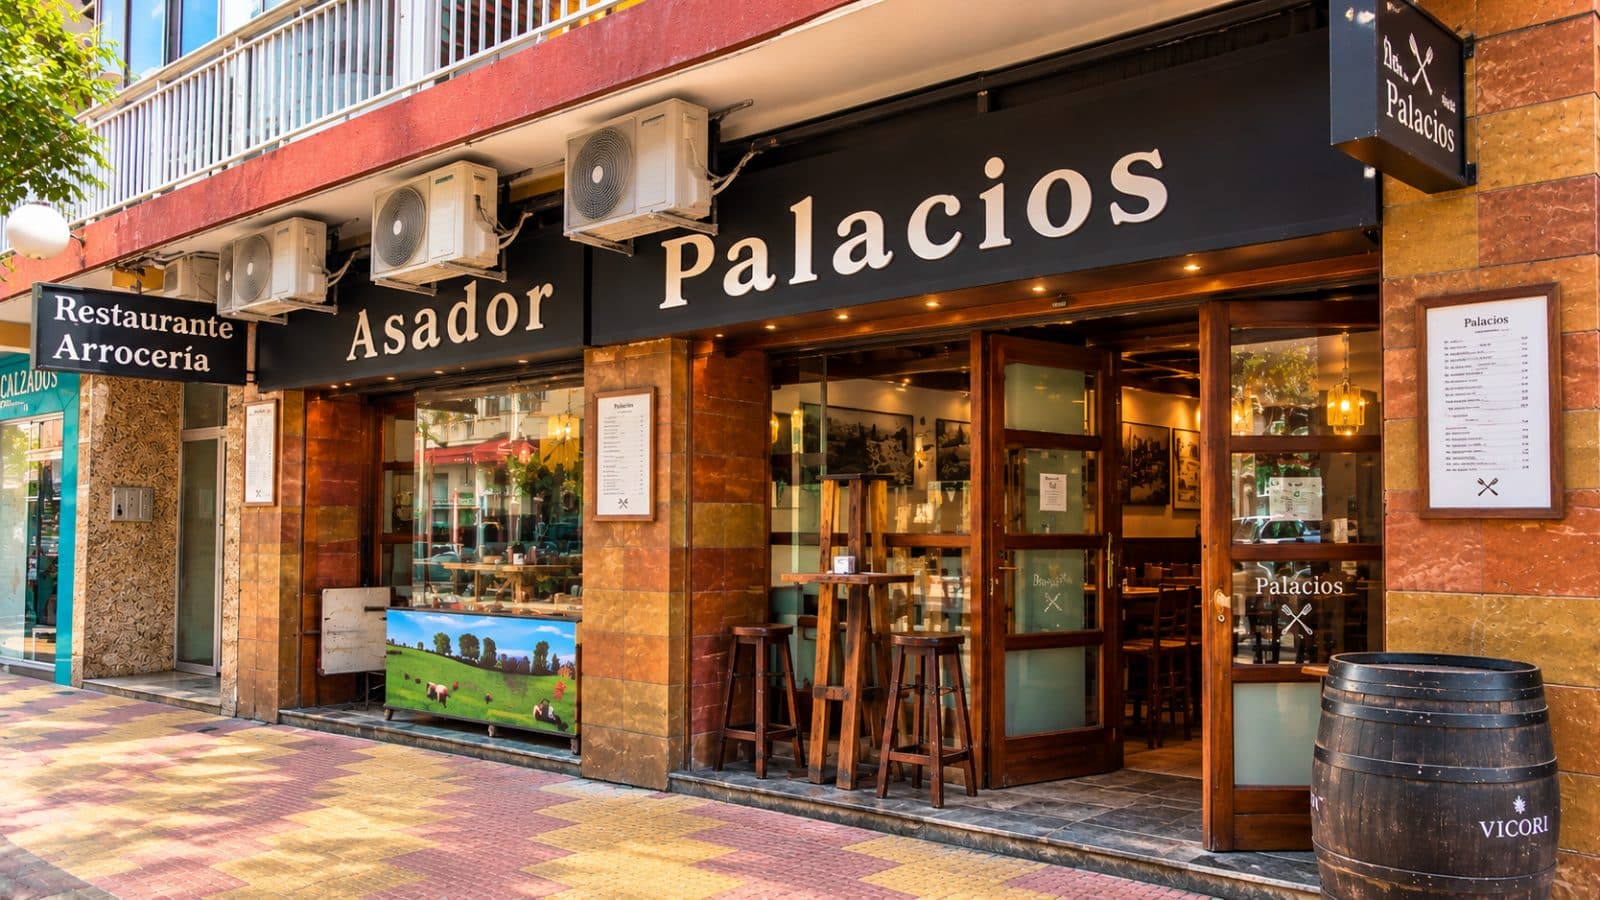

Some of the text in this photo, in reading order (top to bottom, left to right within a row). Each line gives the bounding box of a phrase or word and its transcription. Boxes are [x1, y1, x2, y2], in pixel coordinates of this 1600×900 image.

[1385, 79, 1456, 153] Palacios
[659, 147, 1169, 310] Palacios
[53, 294, 234, 340] Restaurante
[346, 279, 554, 361] Asador
[1464, 316, 1509, 328] Palacios
[52, 333, 211, 373] Arrocería
[0, 369, 58, 399] CALZADOS
[1256, 575, 1344, 596] Palacios
[1478, 815, 1550, 839] VICORI
